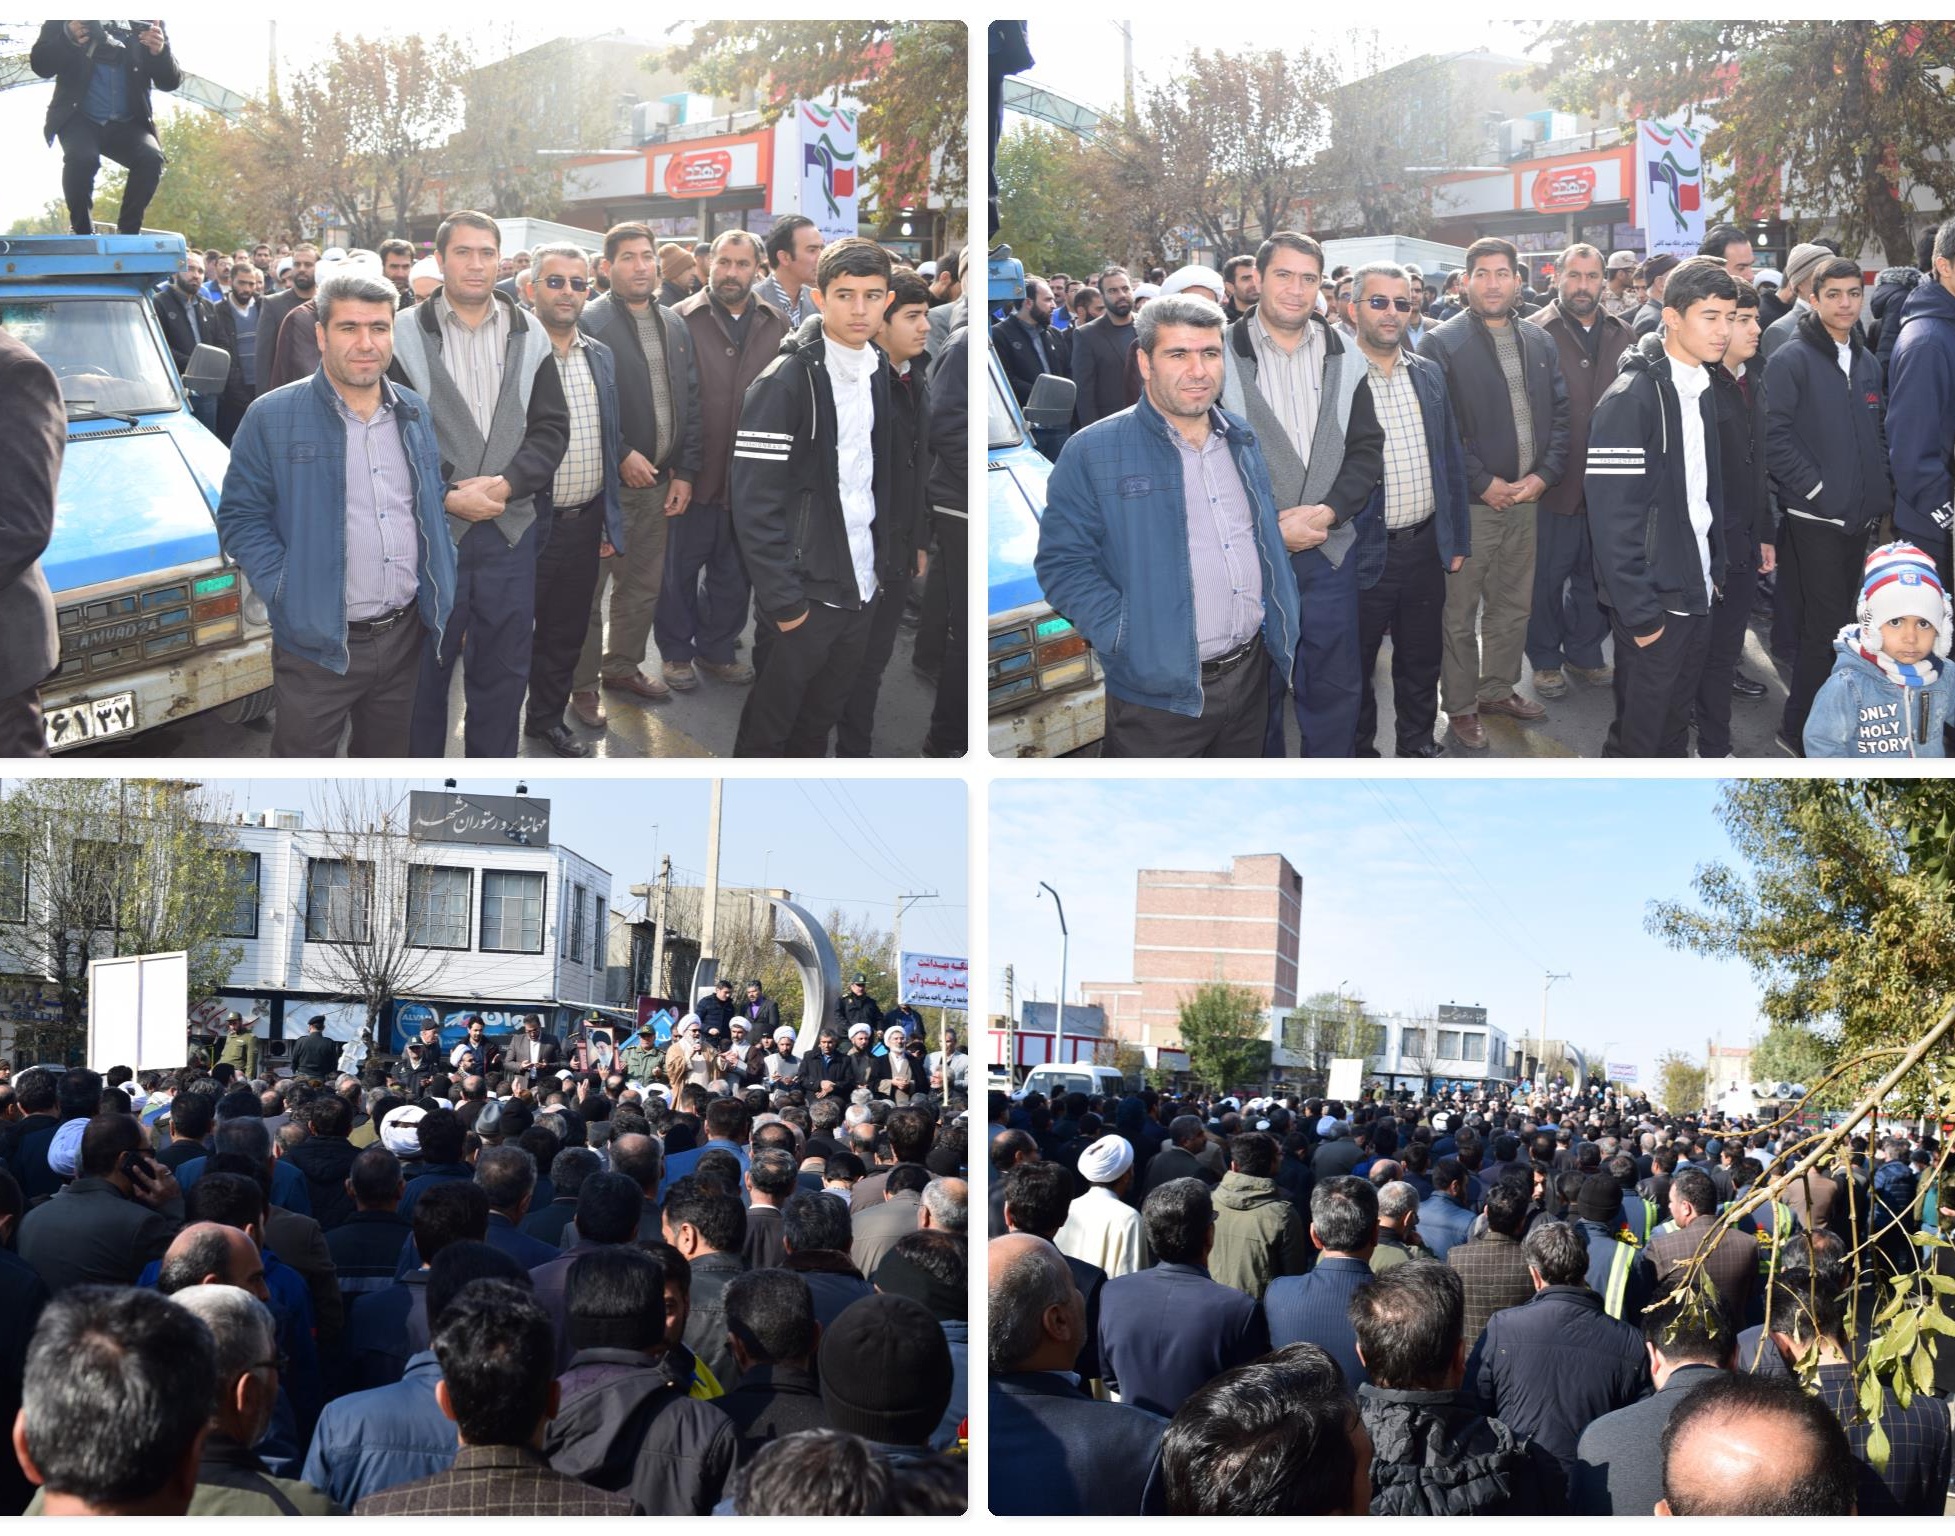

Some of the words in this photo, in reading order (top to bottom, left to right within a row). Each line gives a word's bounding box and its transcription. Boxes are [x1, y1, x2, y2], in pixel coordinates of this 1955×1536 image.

[1859, 703, 1898, 722] ONLY
[1860, 721, 1900, 739] HOLY
[1858, 736, 1910, 754] STORY
[452, 809, 499, 834] رستوران
